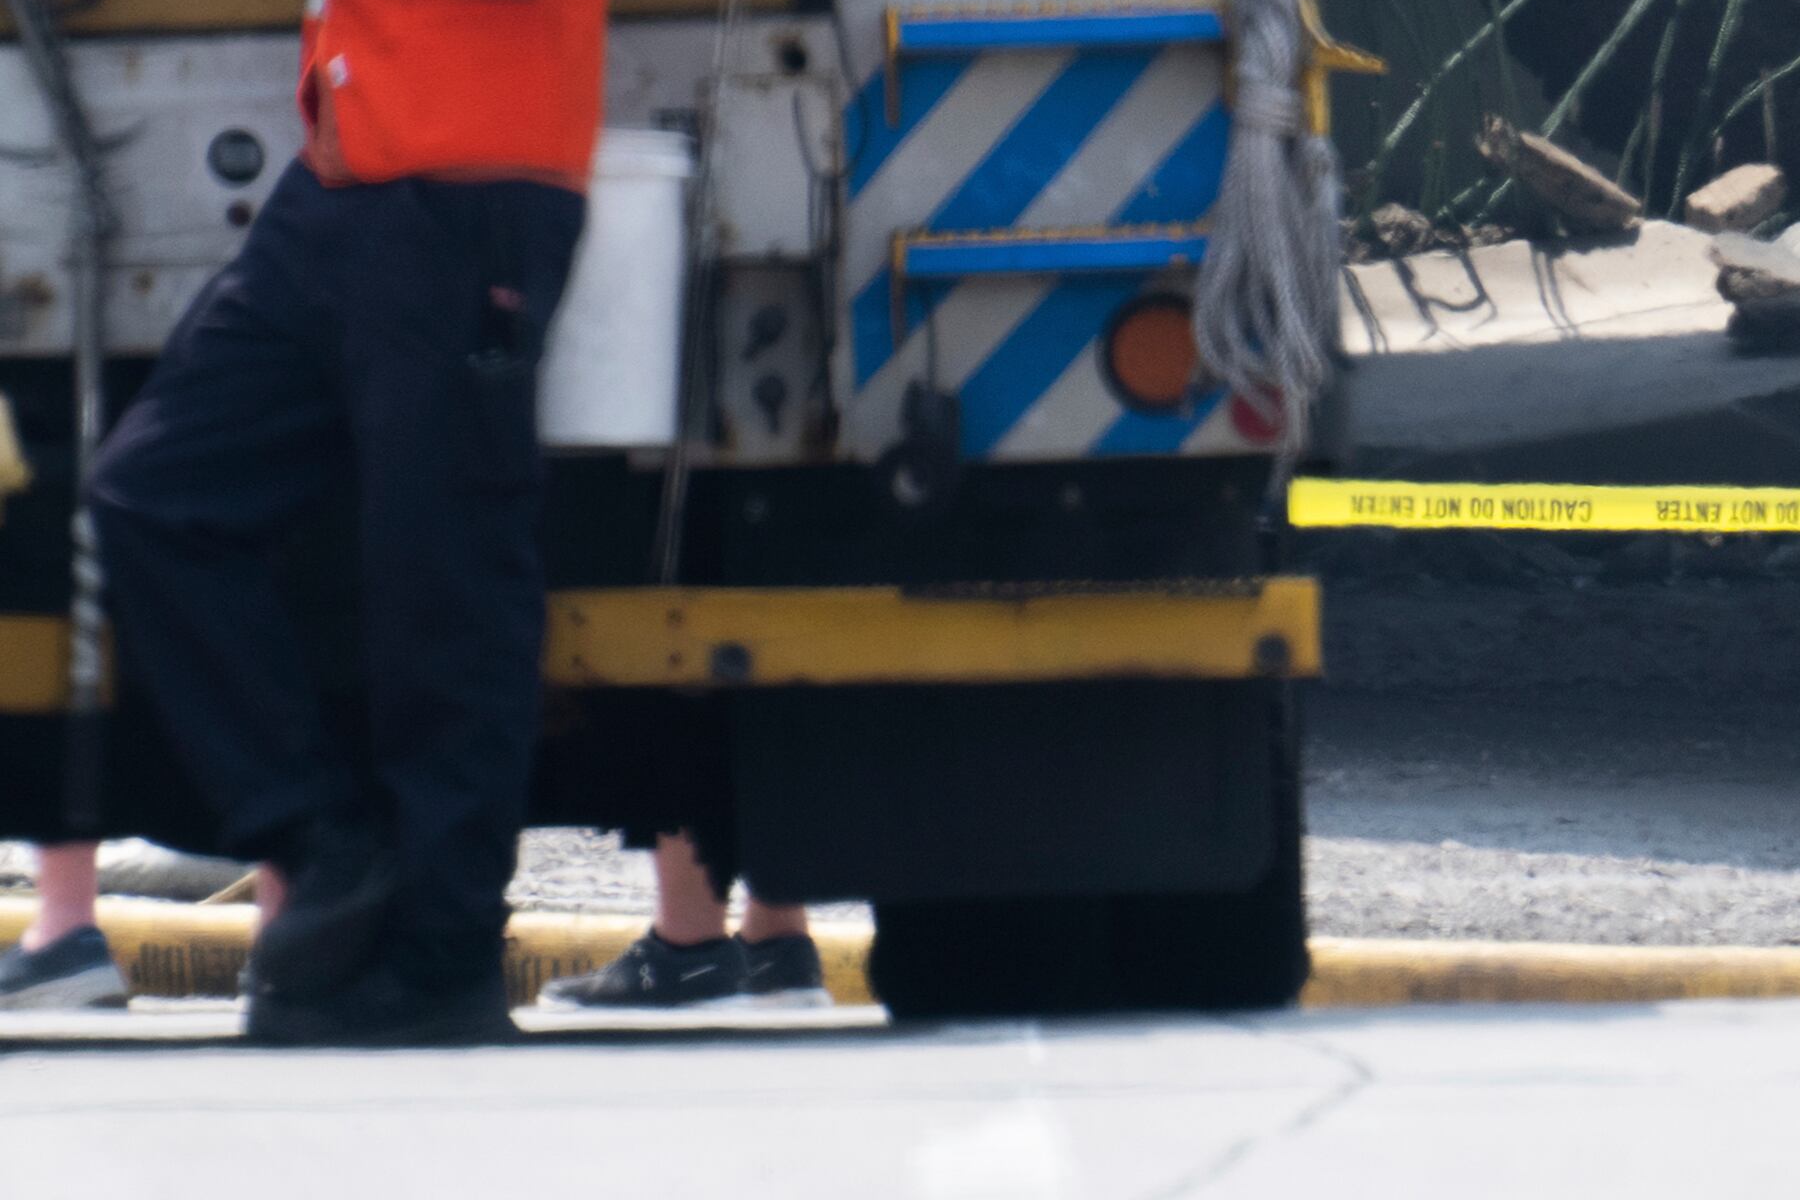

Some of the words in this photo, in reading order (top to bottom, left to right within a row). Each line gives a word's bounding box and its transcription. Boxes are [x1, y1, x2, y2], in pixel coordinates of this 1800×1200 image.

[1422, 496, 1461, 519] NOT
[1470, 497, 1494, 519] DO
[1502, 498, 1592, 522] CAUTION
[1656, 500, 1721, 522] ENTER
[1729, 501, 1768, 523] NOT
[1776, 501, 1800, 523] DO
